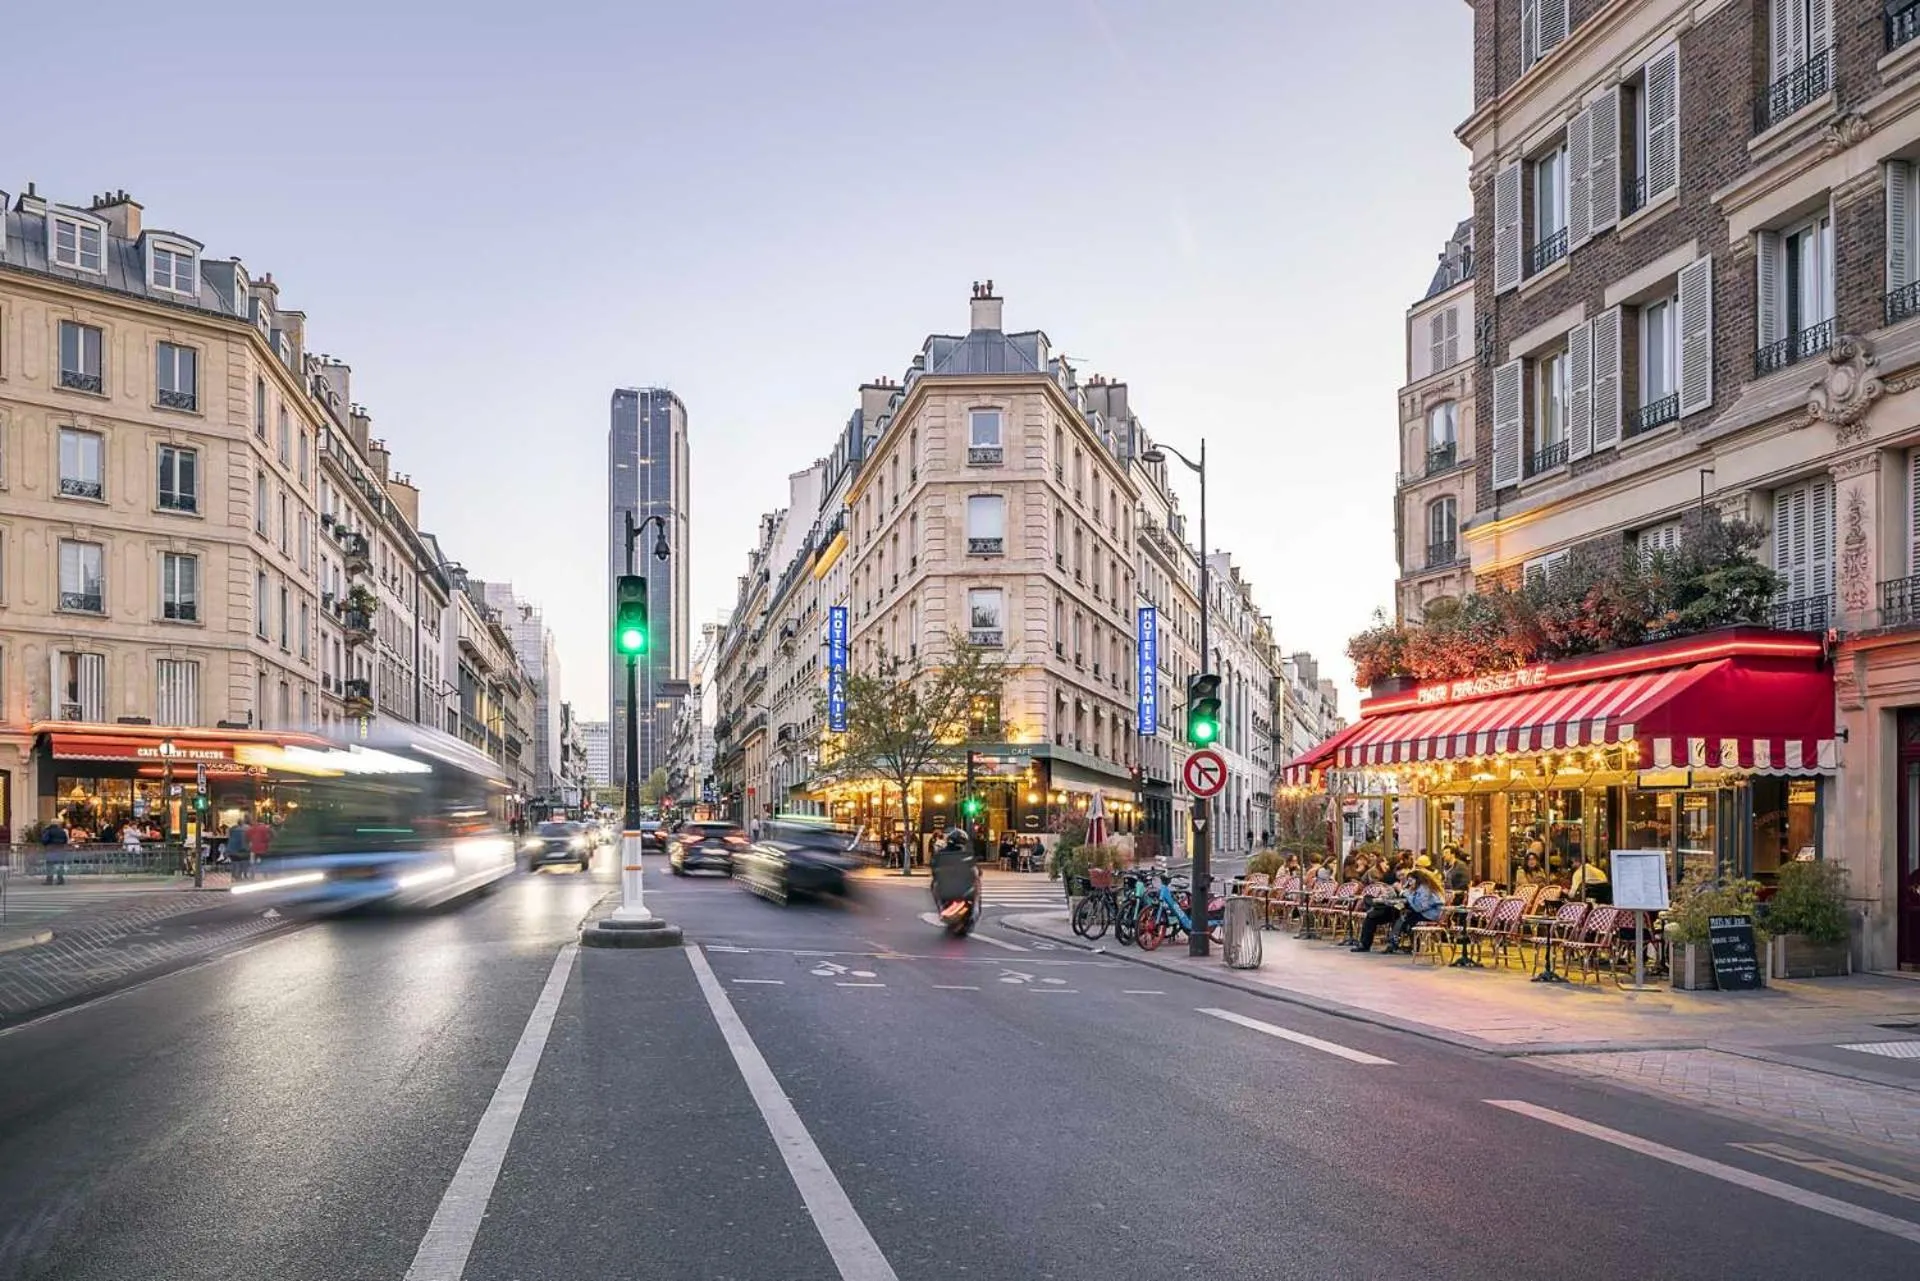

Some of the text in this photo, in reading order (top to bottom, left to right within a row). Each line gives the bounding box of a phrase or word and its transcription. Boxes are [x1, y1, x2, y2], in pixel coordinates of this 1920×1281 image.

[834, 609, 843, 659] HOTEL
[1142, 611, 1154, 725] HOTEL ARAMIS
[1452, 666, 1546, 698] BRASSERIE
